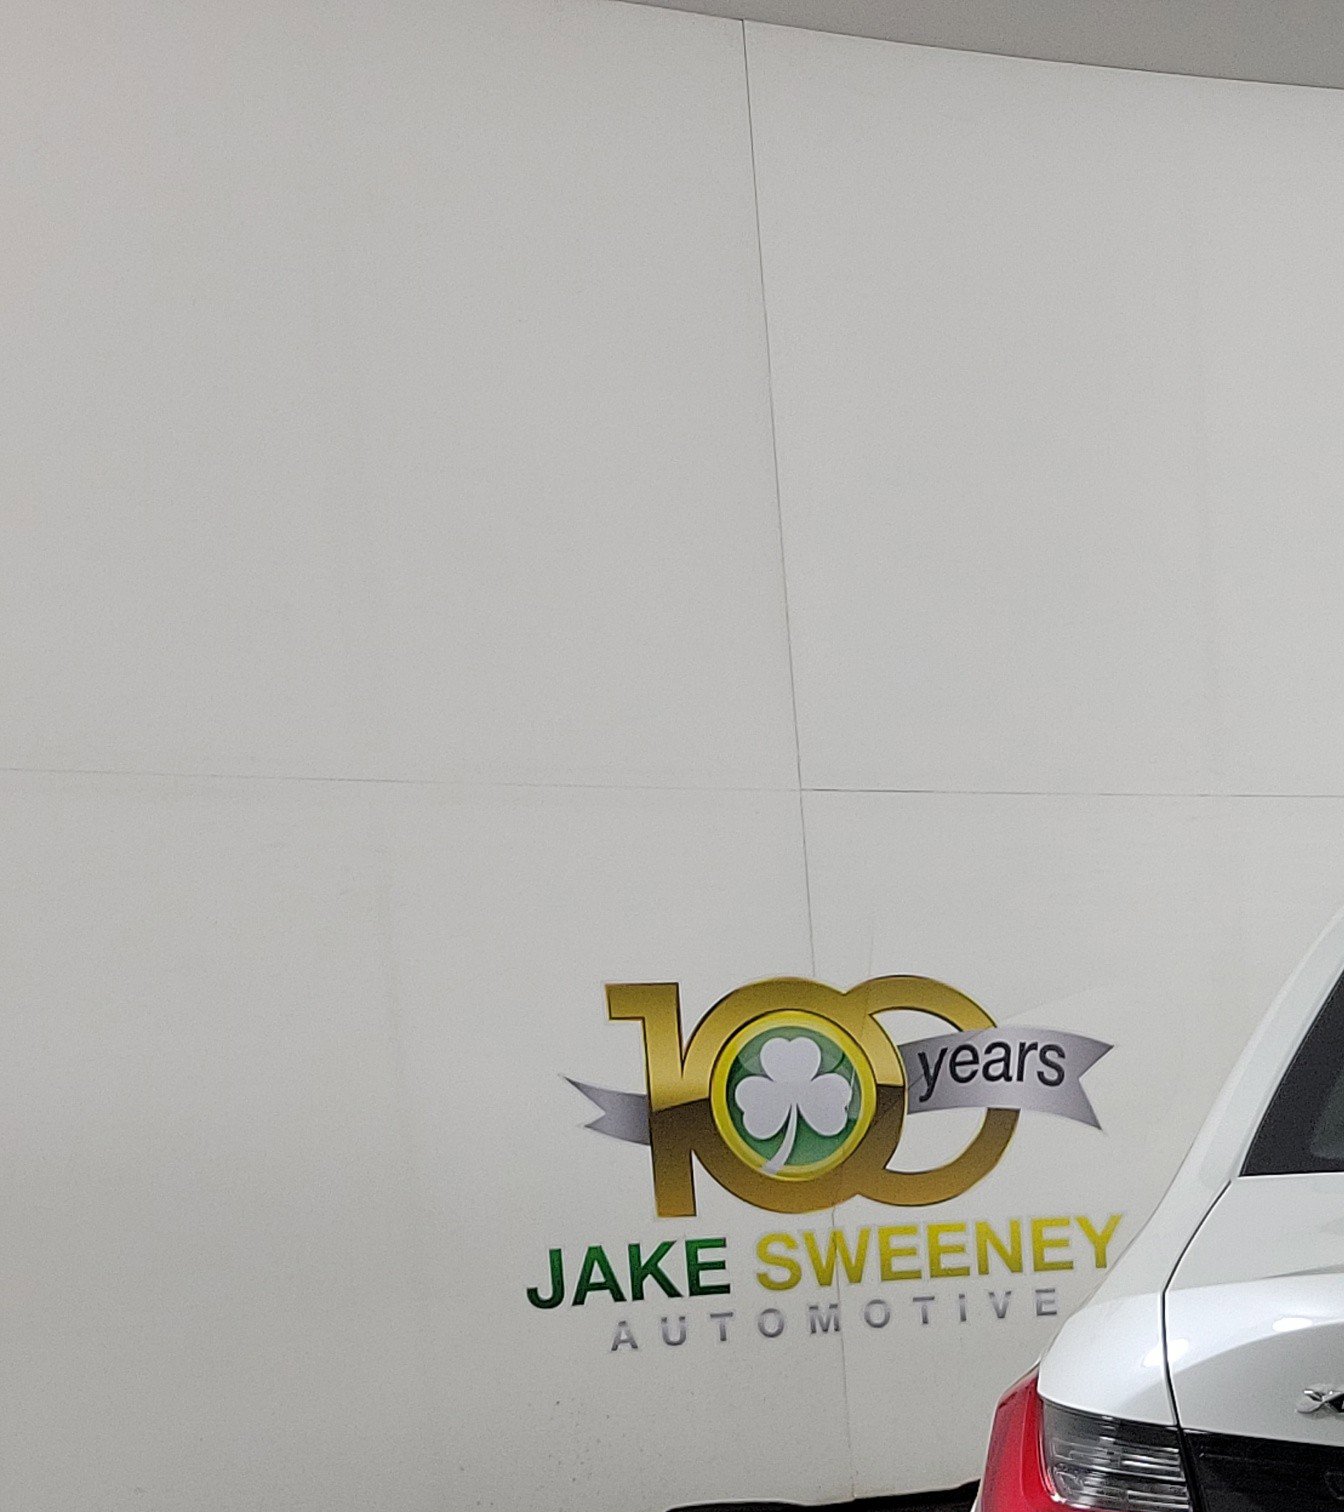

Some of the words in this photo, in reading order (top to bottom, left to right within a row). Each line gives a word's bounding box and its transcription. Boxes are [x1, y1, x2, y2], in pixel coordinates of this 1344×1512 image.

[605, 974, 1020, 1218] 100
[917, 1037, 1066, 1103] years
[526, 1237, 731, 1310] JAKE
[756, 1214, 1124, 1291] SWEENEY
[610, 1287, 1059, 1353] AUTOMOTIVE
